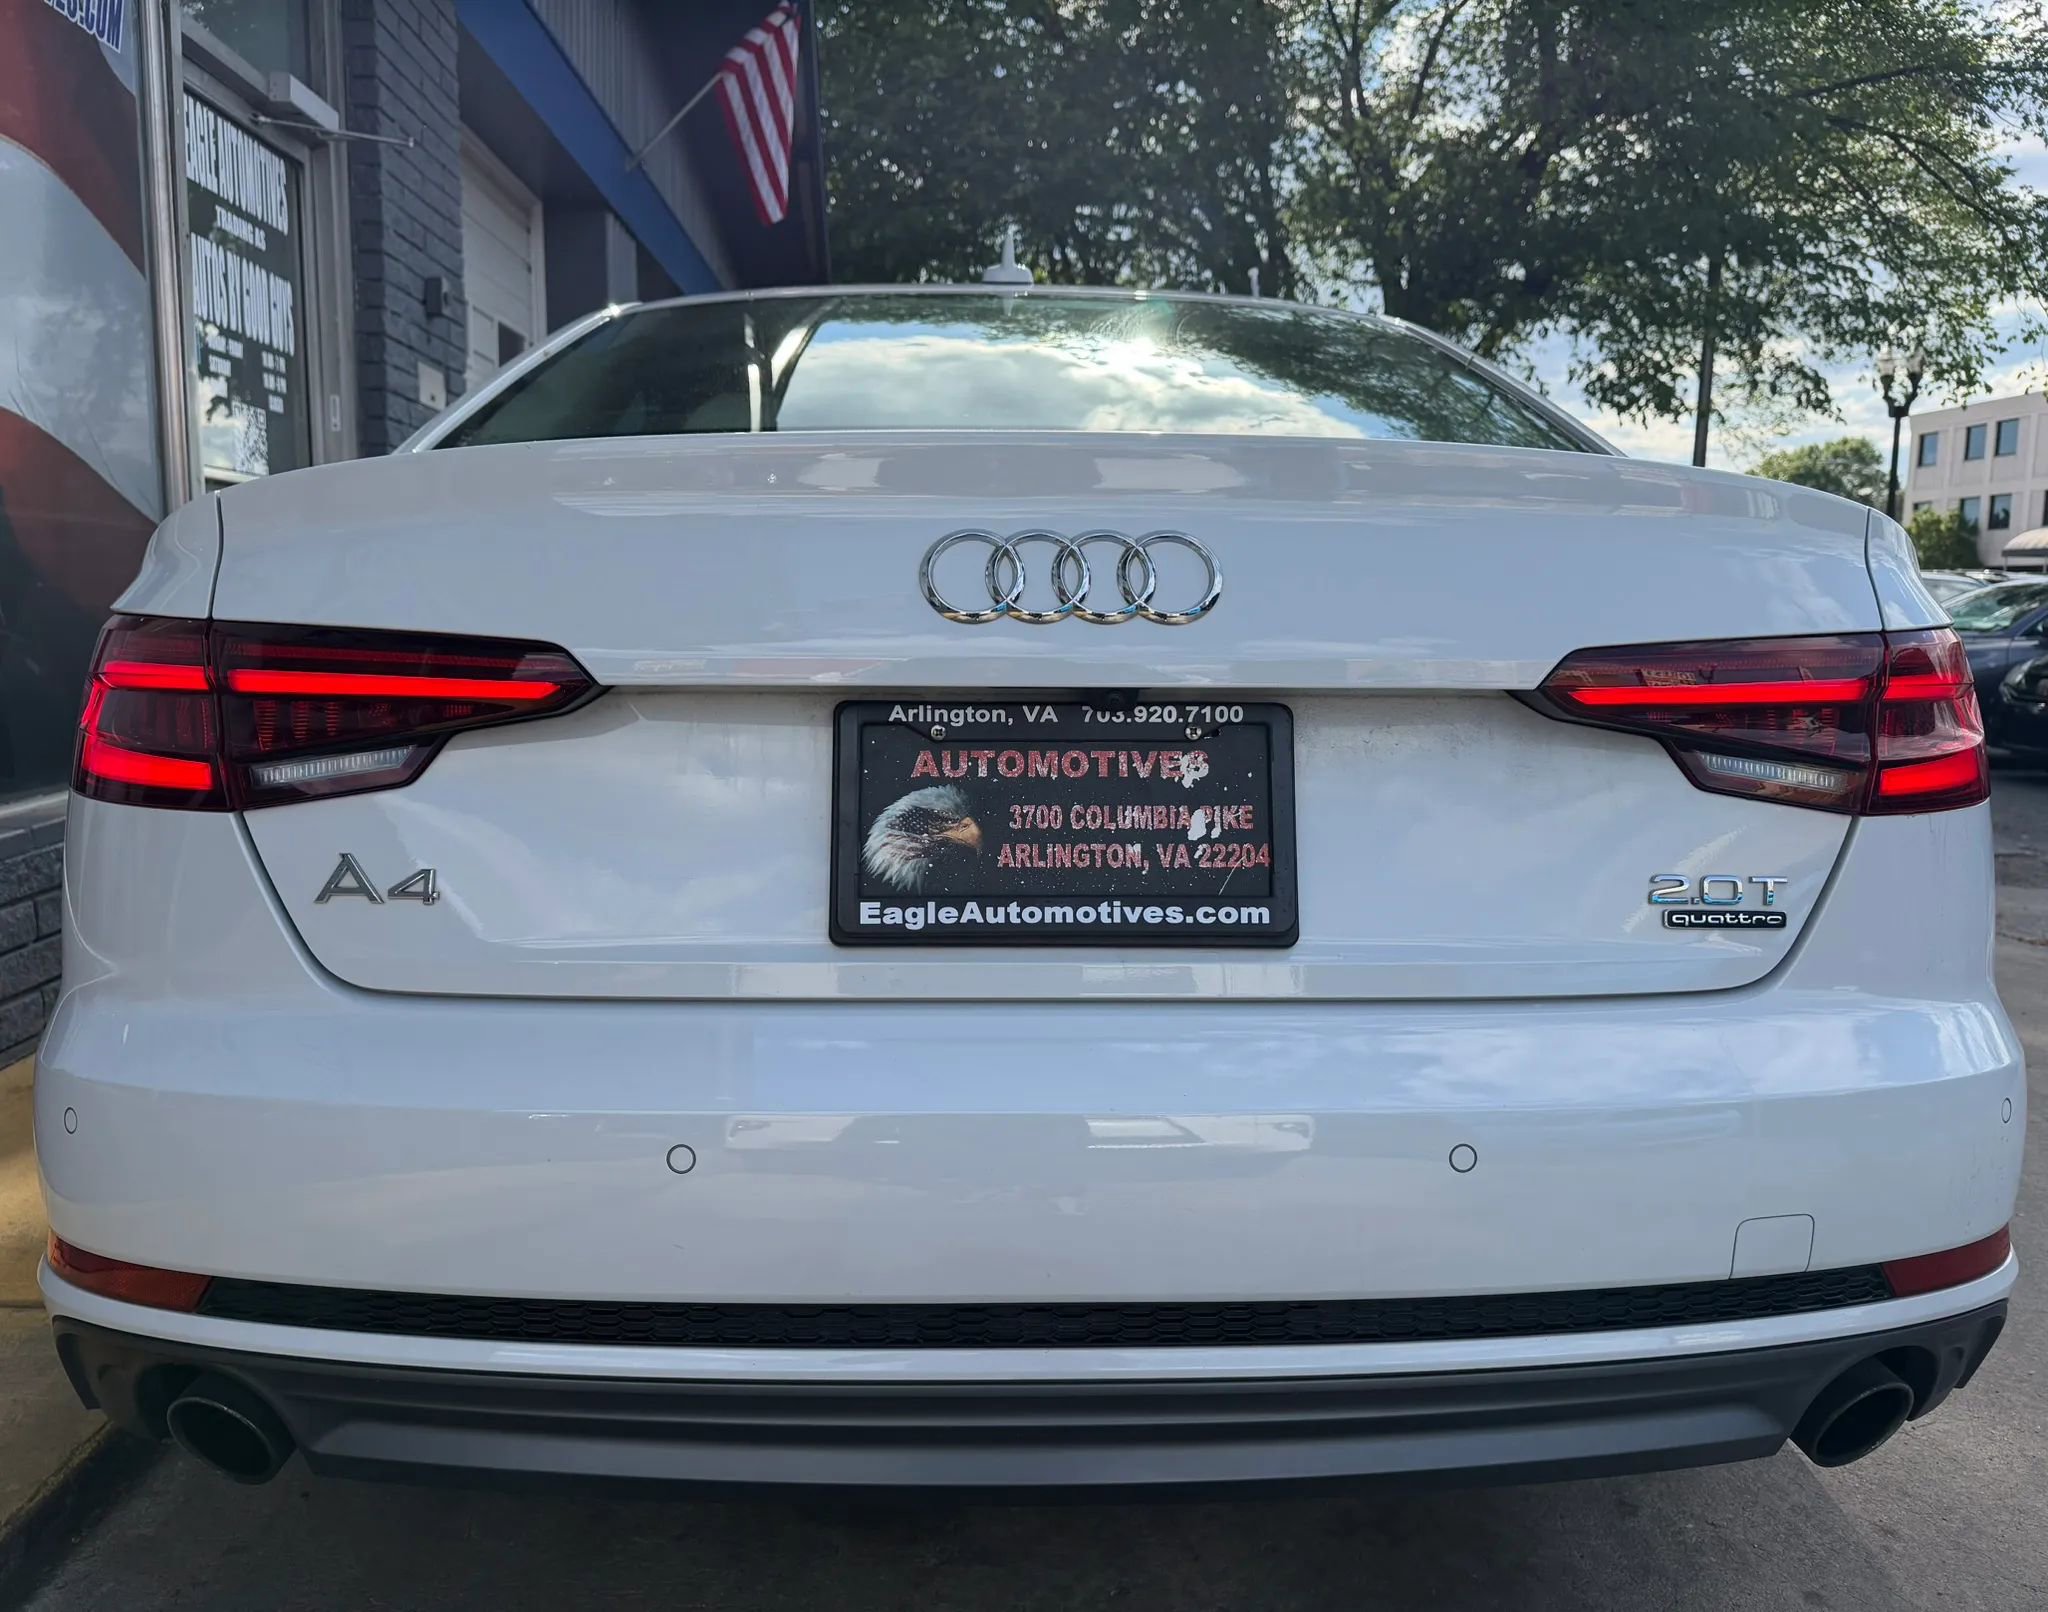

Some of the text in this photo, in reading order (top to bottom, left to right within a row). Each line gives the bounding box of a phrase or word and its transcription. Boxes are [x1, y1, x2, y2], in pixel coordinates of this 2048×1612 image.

[183, 91, 288, 236] EAGLE AUTOMOTIVES
[215, 204, 267, 250] TRADING AS
[191, 231, 295, 357] AUTOS BY GOOD GUYS
[888, 704, 1244, 727] Arlington, VA 703.920.7100
[910, 750, 1209, 779] AUTOMOTIVES
[1008, 804, 1254, 831] 3700 COLUMBIA PIKE
[997, 843, 1271, 872] ARLINGTON, VA 22204
[313, 852, 440, 905] A4
[1648, 874, 1788, 906] 2.0T
[859, 901, 1271, 931] EagleAutomotives.com
[1671, 913, 1783, 927] quattro
